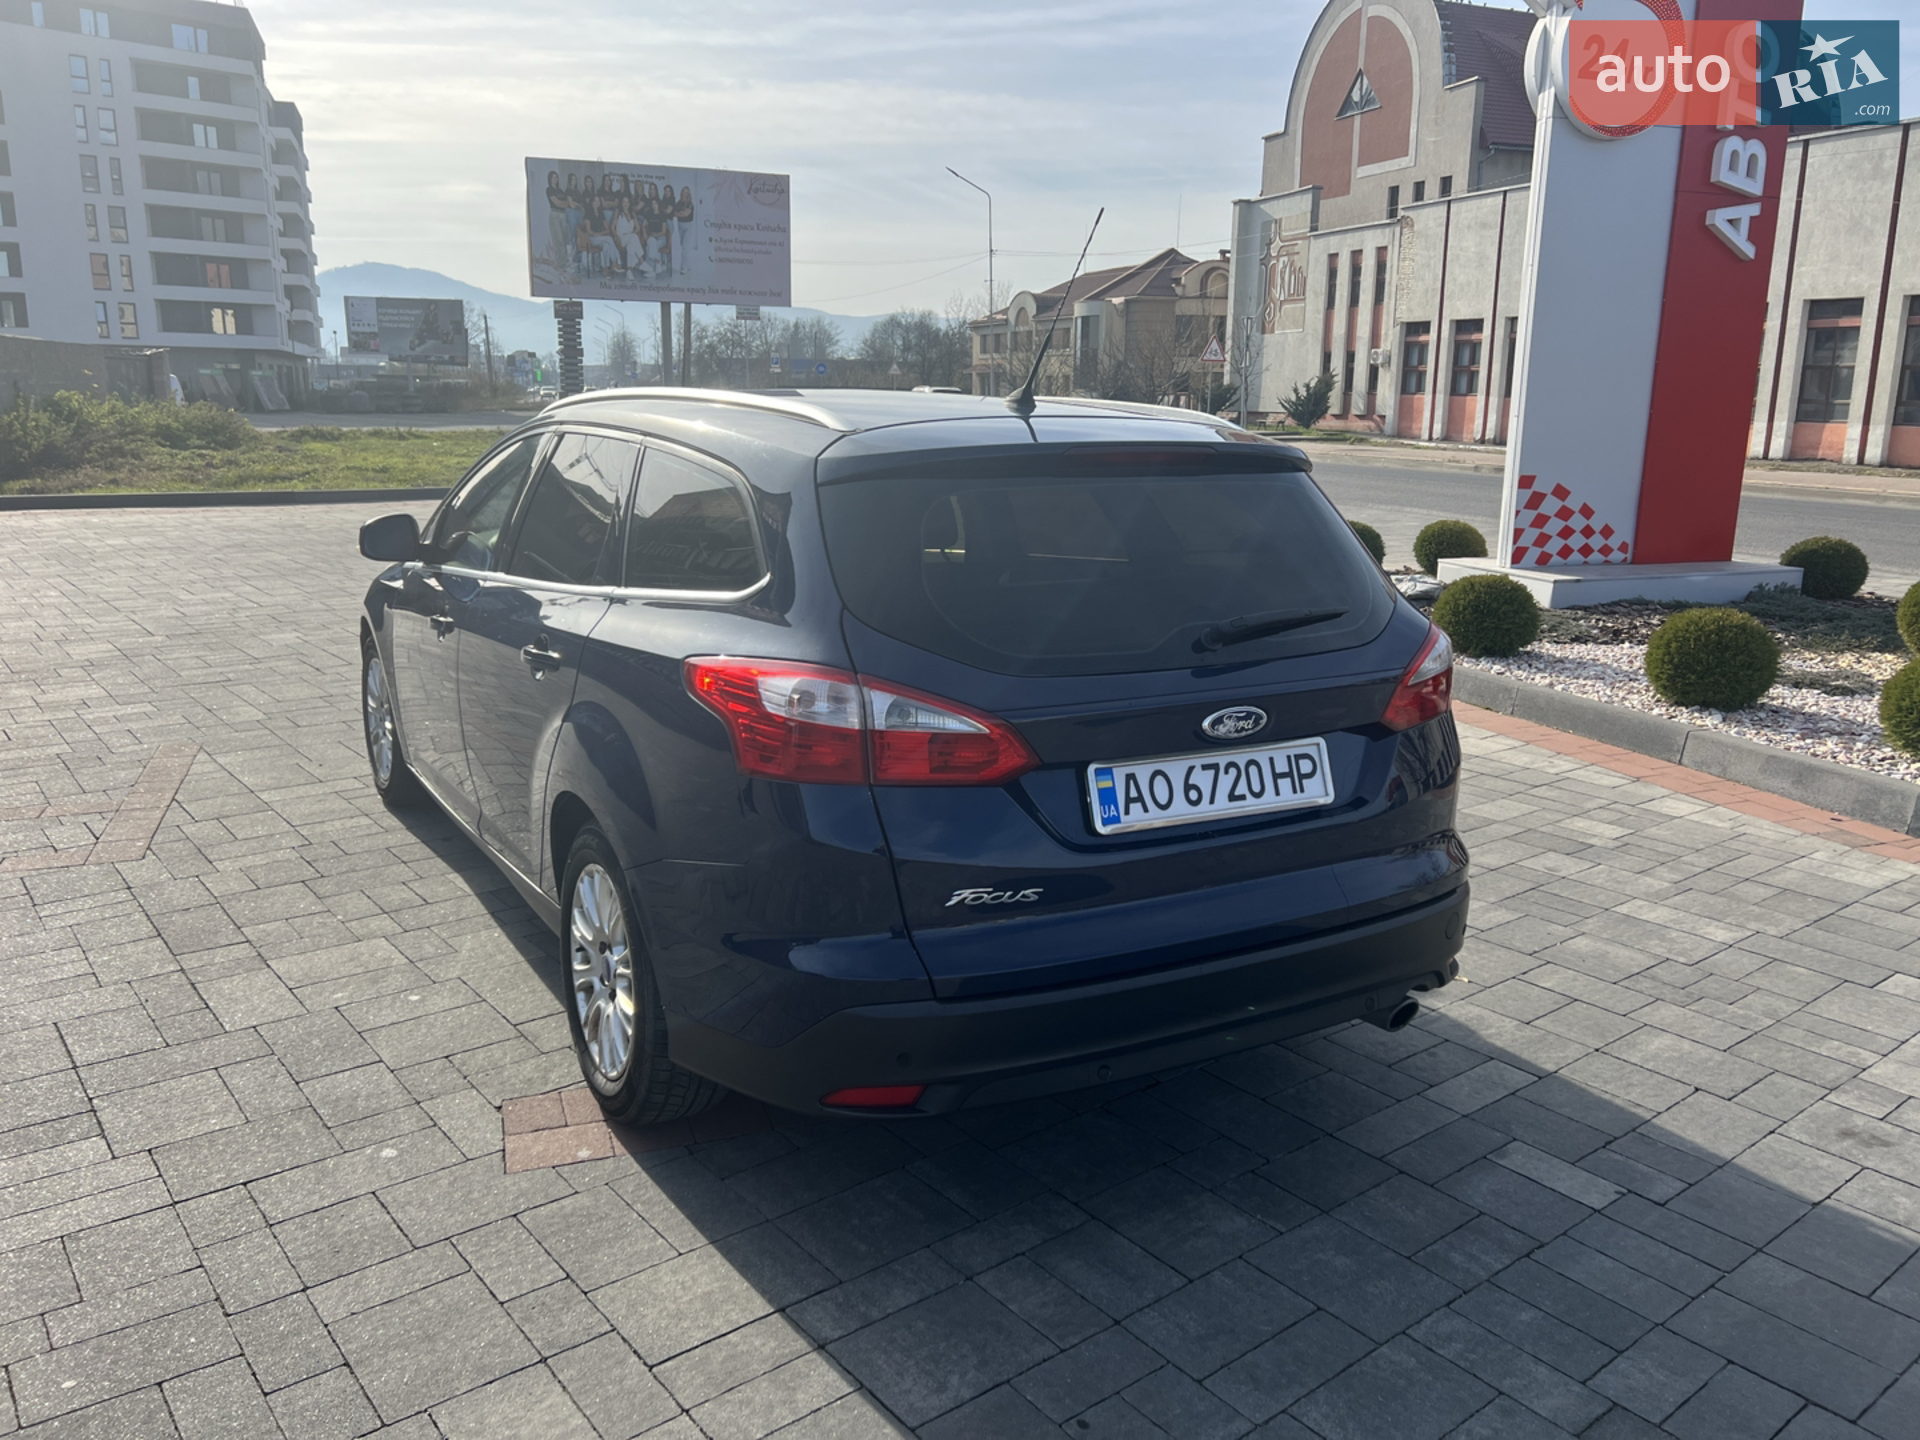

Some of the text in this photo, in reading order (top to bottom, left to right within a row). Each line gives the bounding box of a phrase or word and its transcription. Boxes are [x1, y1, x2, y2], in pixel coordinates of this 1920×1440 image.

[1214, 711, 1256, 734] Ford
[1100, 753, 1317, 818] UA AO 6720 HP
